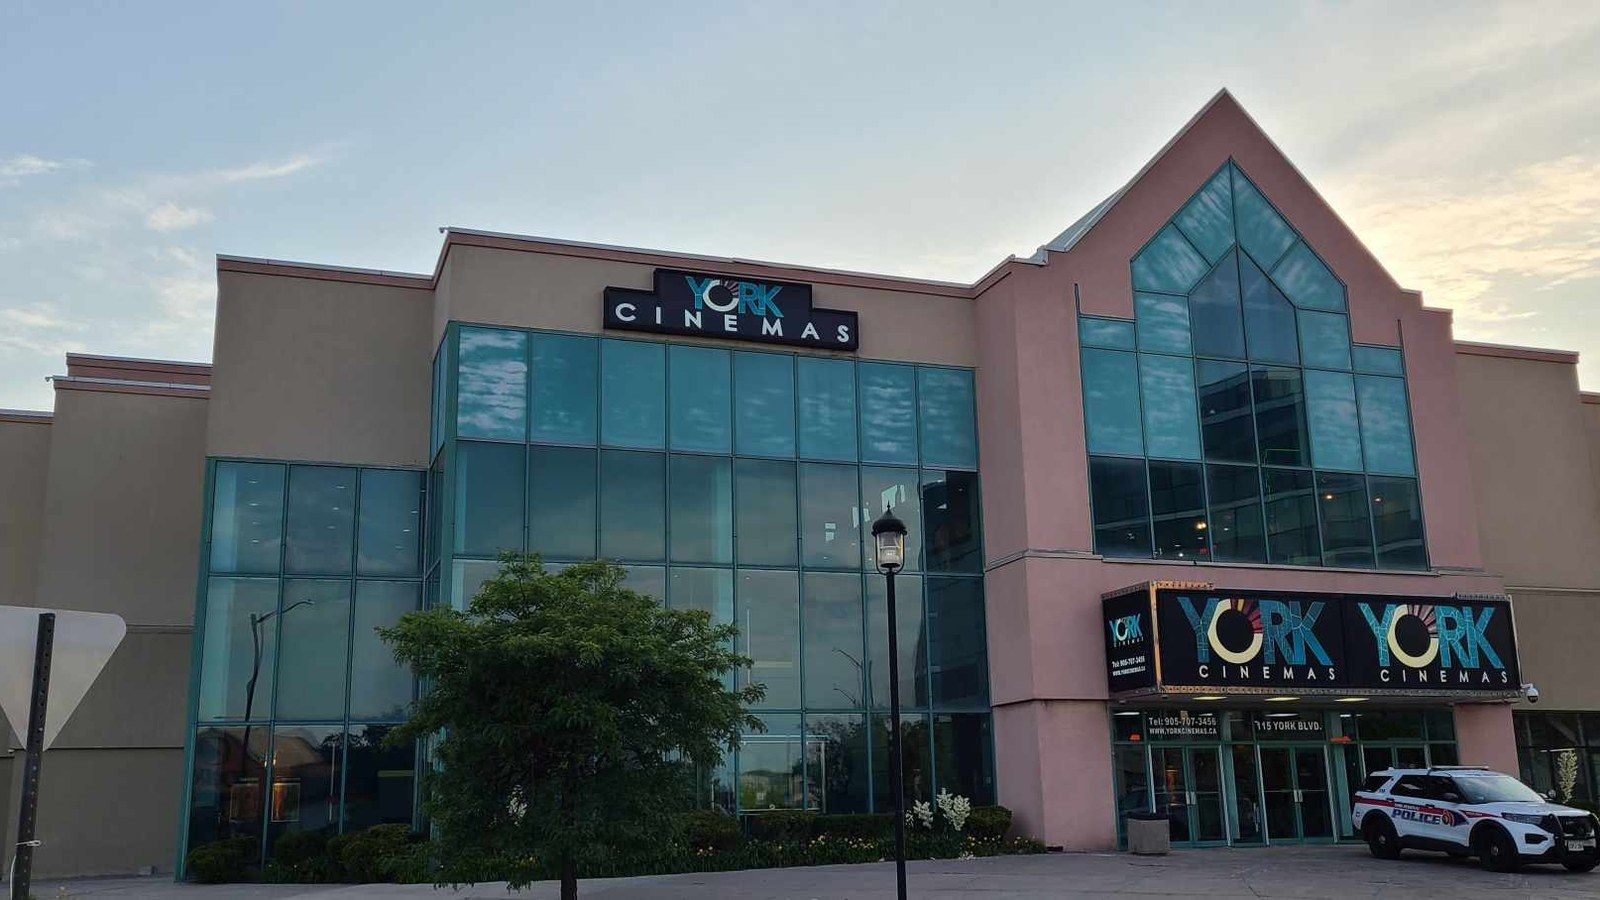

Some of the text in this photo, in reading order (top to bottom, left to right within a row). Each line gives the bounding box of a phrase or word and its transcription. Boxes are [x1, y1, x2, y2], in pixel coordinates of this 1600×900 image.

[685, 276, 785, 318] YORK
[615, 303, 850, 343] CINEMAS
[1109, 613, 1142, 647] YORK
[1177, 597, 1333, 666] YORK
[1358, 602, 1505, 669] YORK
[1199, 665, 1336, 680] CINEMAS
[1380, 669, 1508, 683] CINEMAS
[1149, 717, 1217, 726] Tel: 905-707-3456
[1273, 721, 1296, 731] YORK
[1298, 721, 1323, 731] BLVD.
[1391, 808, 1440, 825] POLICE
